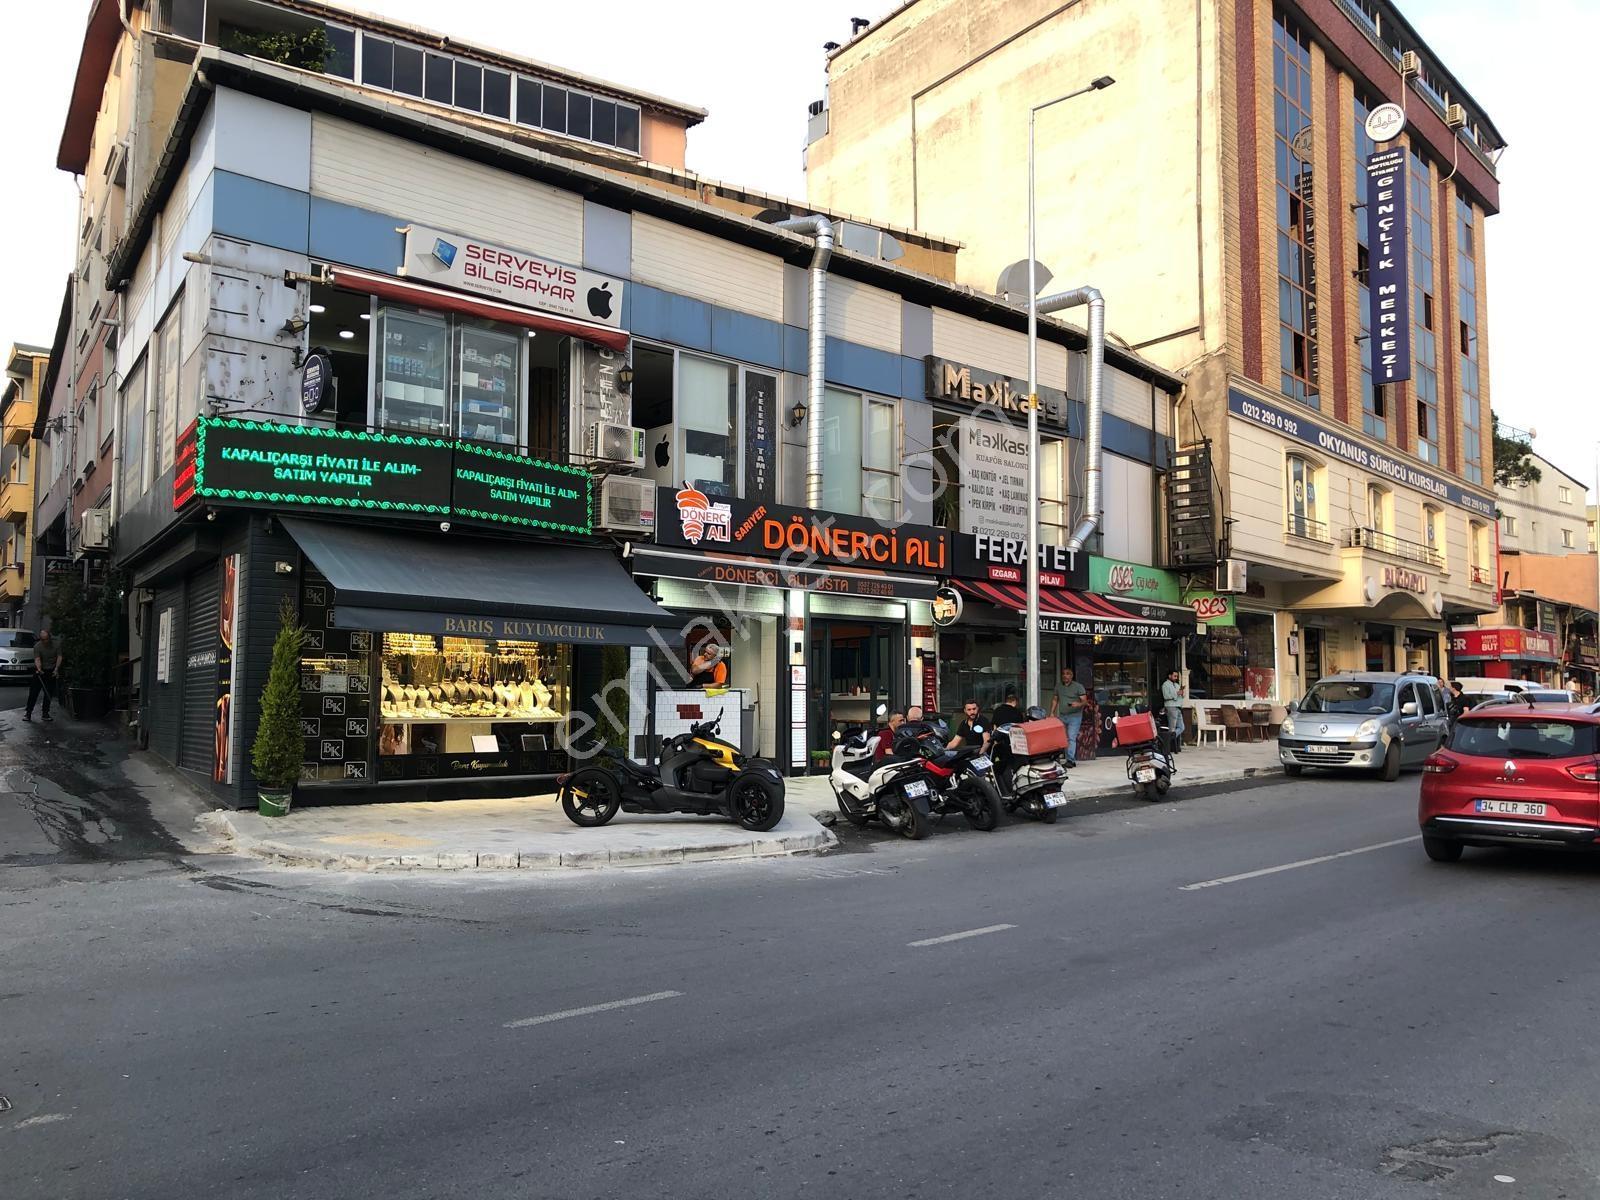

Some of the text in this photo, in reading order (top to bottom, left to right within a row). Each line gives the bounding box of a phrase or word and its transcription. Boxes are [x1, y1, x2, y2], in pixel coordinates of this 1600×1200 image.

[465, 244, 577, 285] SERVEYİS
[464, 263, 576, 303] BİLGİSAYAR
[1377, 176, 1397, 378] GENÇLİK MERKEZİ
[757, 391, 765, 440] TELEFON
[976, 454, 1002, 466] KUAFÖR
[1242, 402, 1260, 420] 0212
[1261, 409, 1276, 426] 299
[1276, 416, 1283, 429] 0
[1284, 419, 1298, 436] 992
[1319, 431, 1368, 465] OKYANUS
[1369, 454, 1407, 481] SÜRÜCÜ
[1408, 470, 1448, 498] KURSLARI
[221, 447, 422, 475] KAPALIÇARŞI FİYATI İLE ALIM-
[273, 467, 372, 486] SATIM YAPILIR
[456, 468, 581, 500] KAPALIÇARŞI FİYATI İLE ALIM-
[490, 488, 552, 508] SATIM YAPILIR
[734, 505, 768, 541] SARIYER
[763, 515, 946, 569] DÖNERCİ ALİ
[1053, 545, 1079, 572] ET
[715, 565, 779, 586] DÖNERCİ
[815, 577, 849, 592] USTA
[992, 569, 1061, 586] IZGARA PİLAV
[1190, 597, 1228, 615] oses
[445, 617, 605, 641] BARIŞ KUYUMCULUK
[1050, 619, 1169, 637] ET IZGARA PİLAV 0212 299 99 01
[1481, 642, 1499, 652] BUT
[350, 677, 367, 692] BK
[325, 698, 342, 712] BK
[349, 720, 366, 734] BK
[323, 742, 341, 757] BK
[346, 764, 363, 778] BK
[1481, 801, 1543, 815] 34 CLR 360
